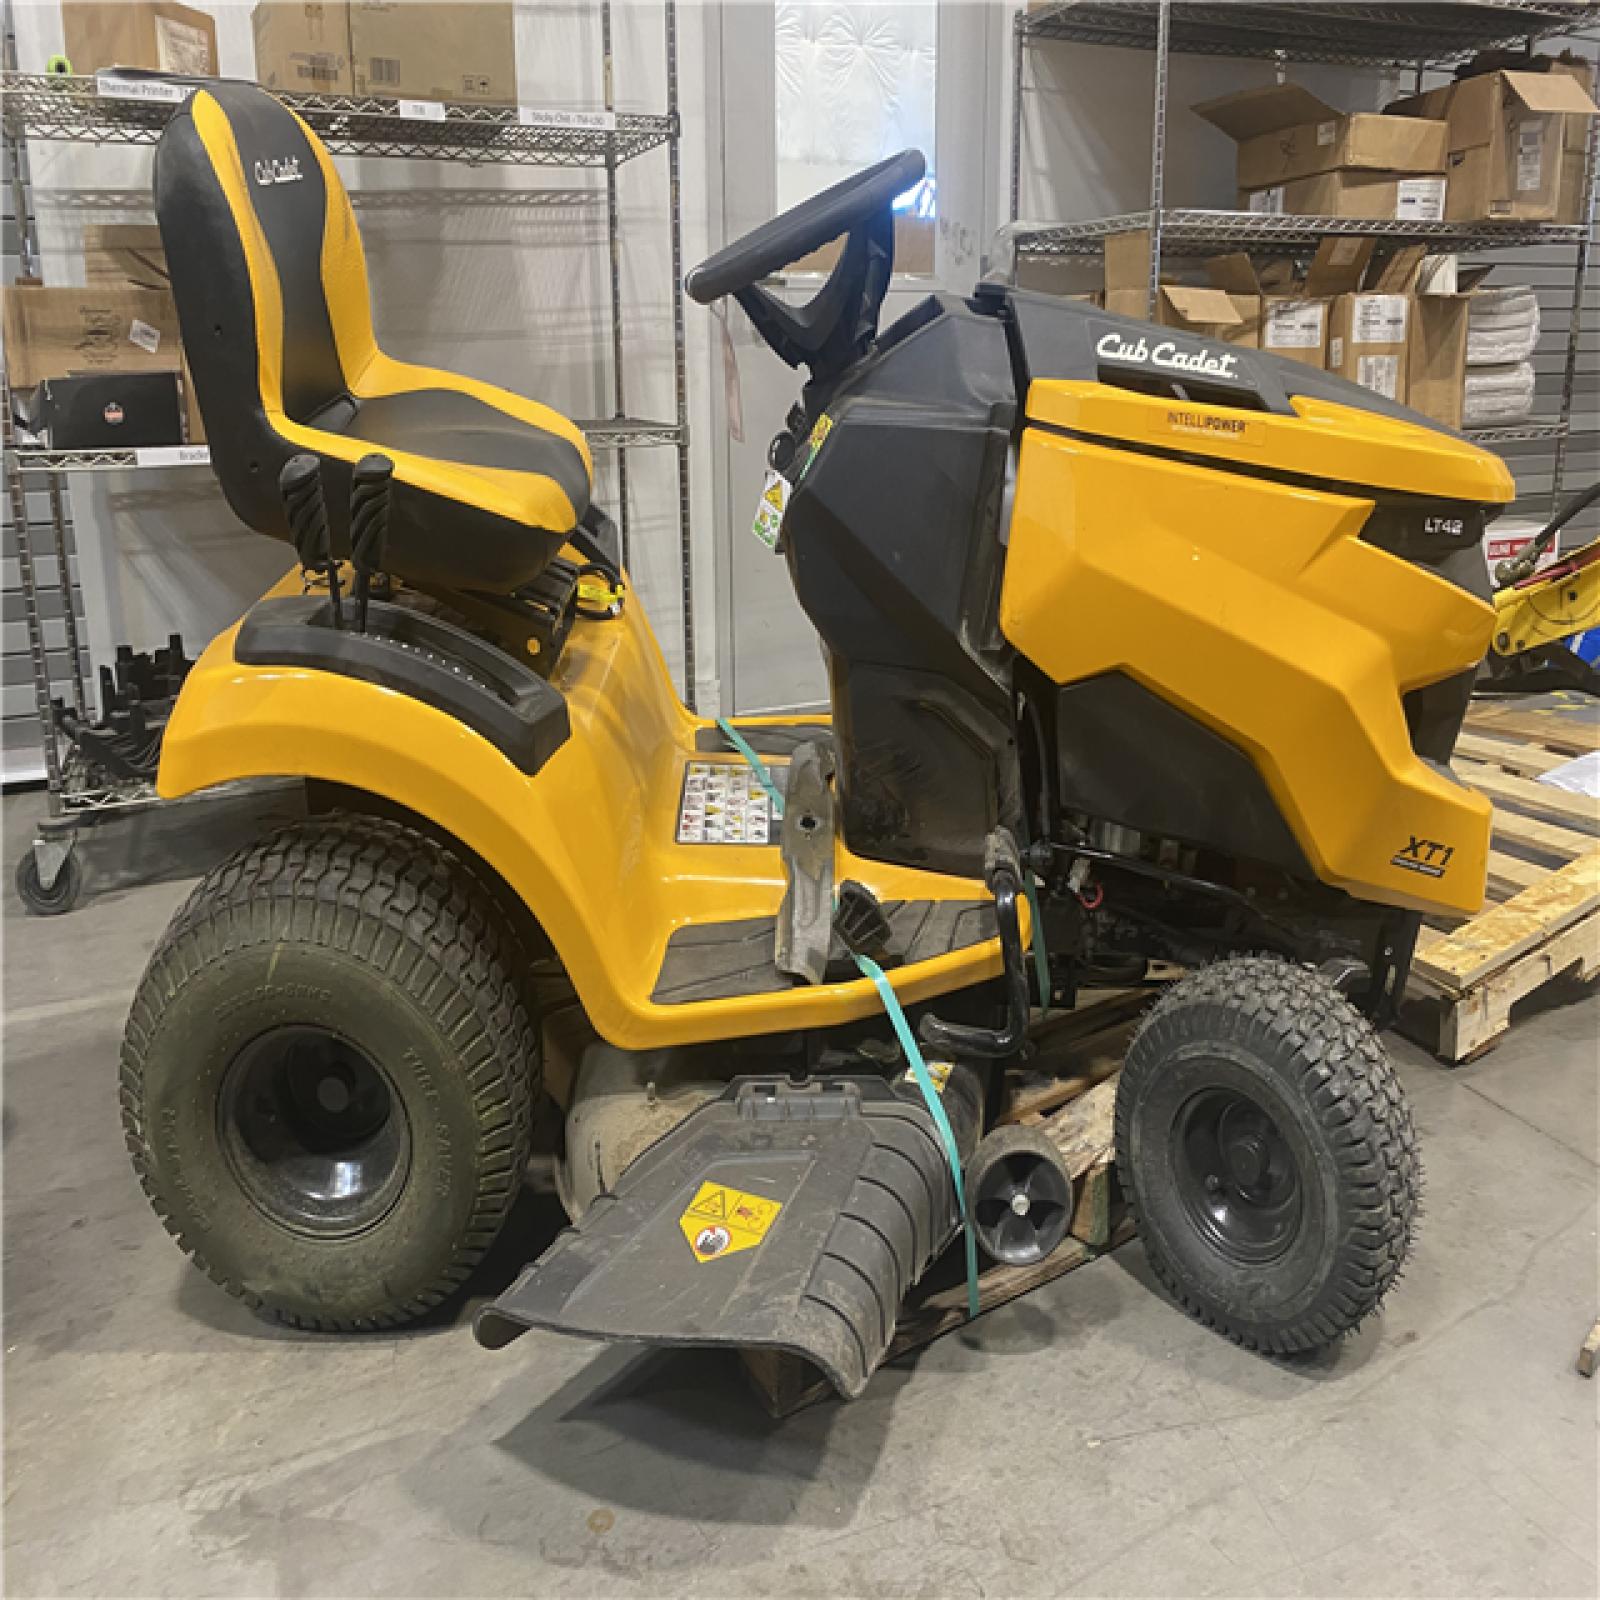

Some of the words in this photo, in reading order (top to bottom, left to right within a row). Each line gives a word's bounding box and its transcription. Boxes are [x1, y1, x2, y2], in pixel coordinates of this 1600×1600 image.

[142, 85, 173, 97] Printer
[254, 160, 275, 186] Cub
[274, 155, 304, 184] Cadet
[1096, 333, 1149, 363] Cub
[1151, 341, 1238, 379] Cadet
[1167, 410, 1247, 433] INTELLIPOWER
[1424, 517, 1464, 536] LT42
[1394, 834, 1455, 867] XT1
